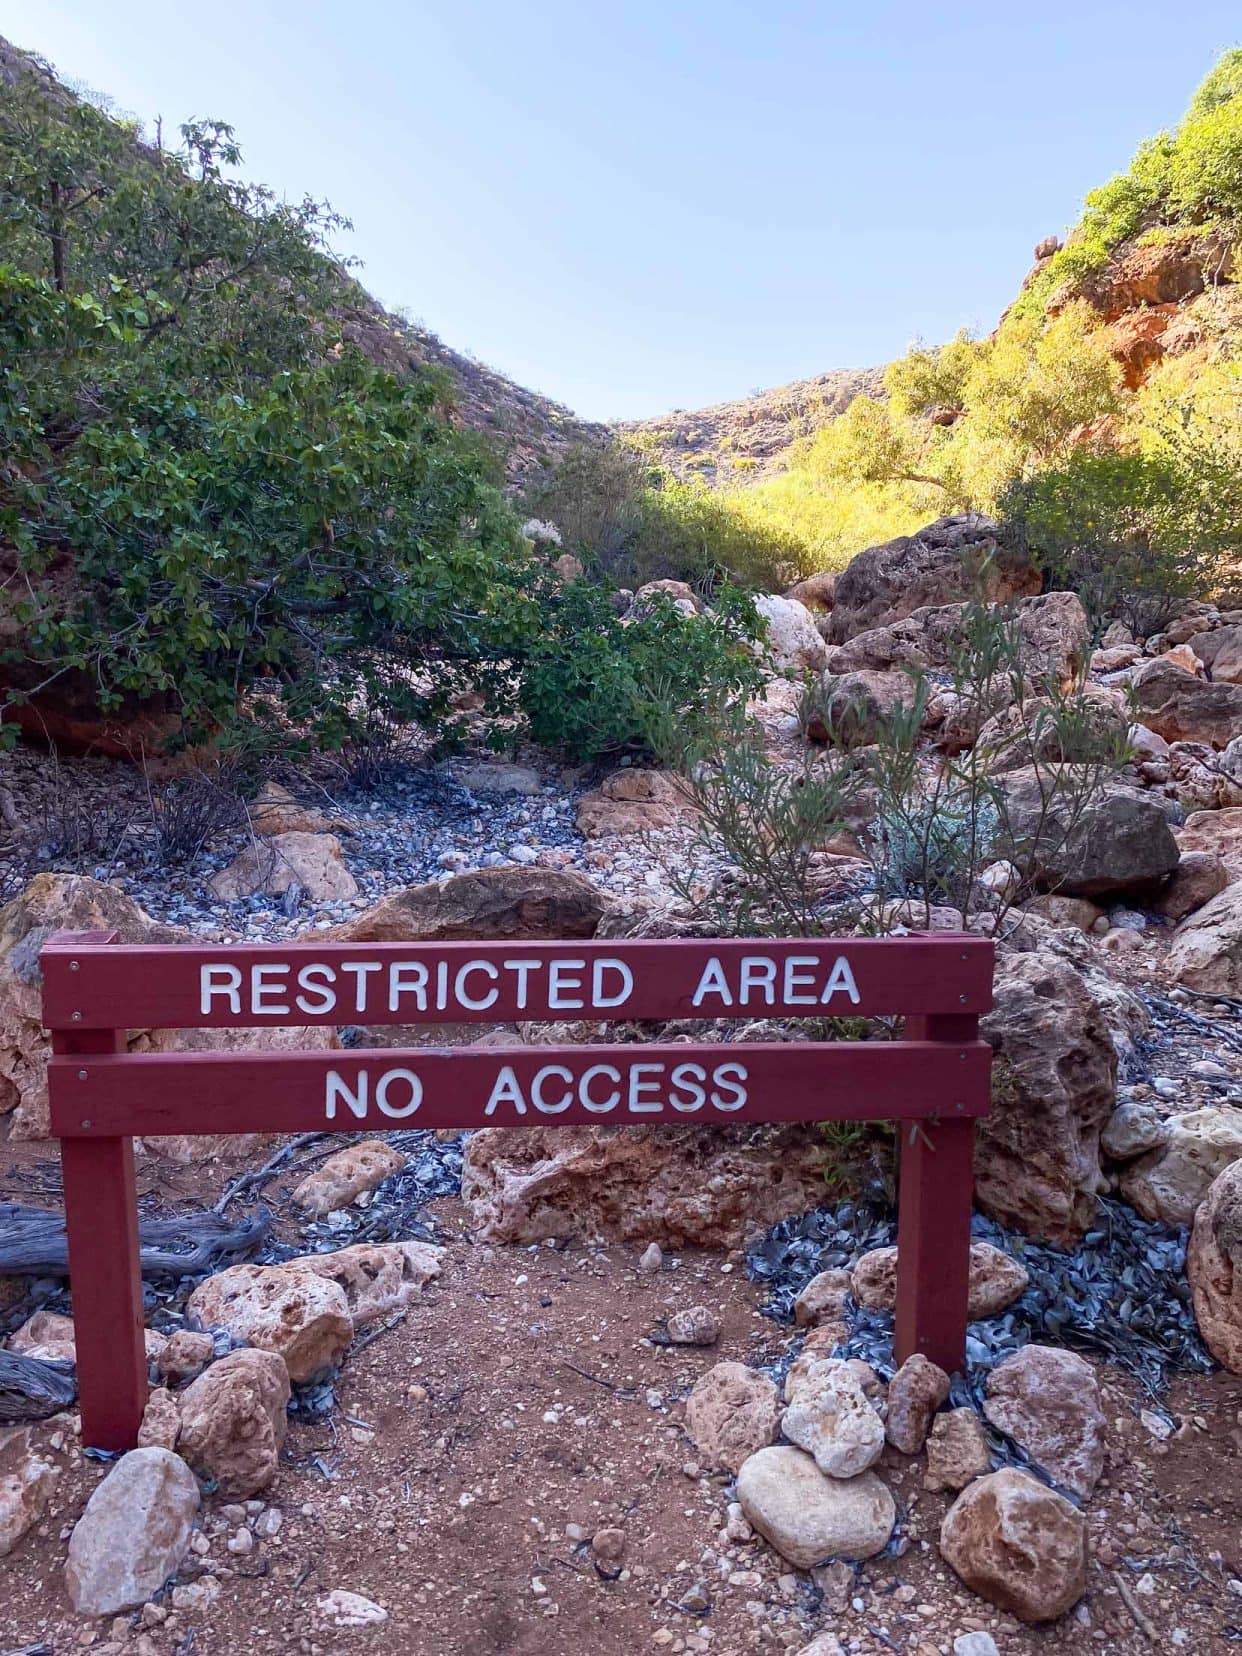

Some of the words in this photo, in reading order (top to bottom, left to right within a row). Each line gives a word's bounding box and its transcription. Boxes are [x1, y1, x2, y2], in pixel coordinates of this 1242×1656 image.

[200, 959, 634, 1015] RESTRICTED
[692, 956, 861, 1007] AREA
[325, 1068, 423, 1120] NO
[484, 1062, 749, 1115] ACCESS
